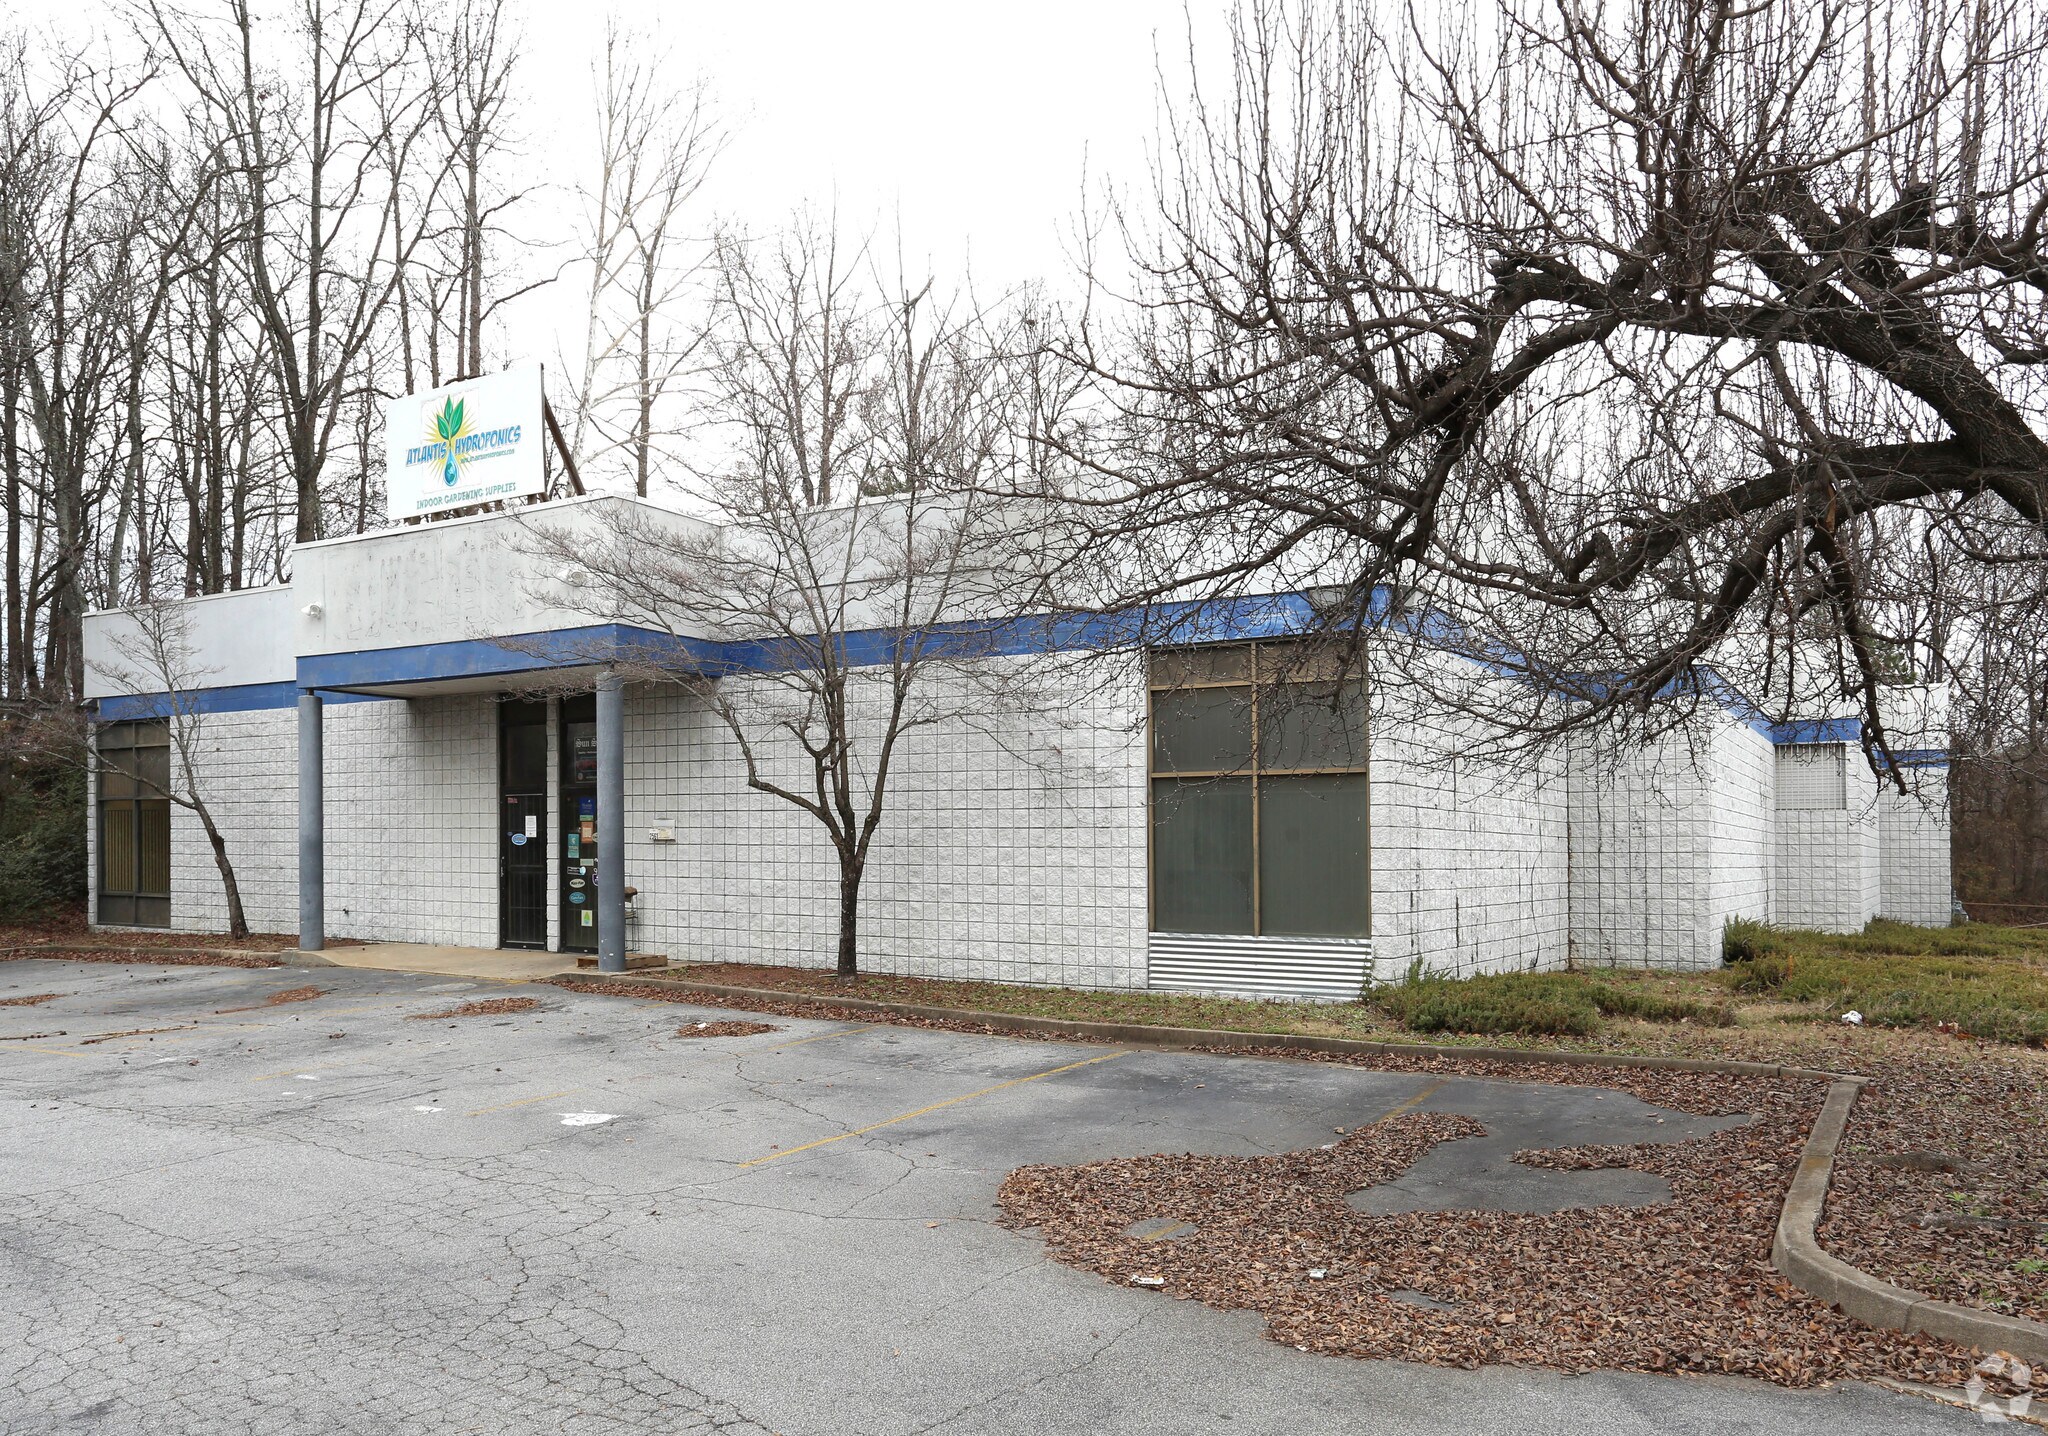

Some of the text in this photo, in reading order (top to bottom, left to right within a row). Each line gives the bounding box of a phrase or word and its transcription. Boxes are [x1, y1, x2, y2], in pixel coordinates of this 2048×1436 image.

[406, 441, 447, 466] ATLANTIS
[455, 425, 521, 455] HYDROPONICS
[417, 482, 516, 510] INDOOR GARDENING SUPPLIES
[575, 737, 590, 748] Sun
